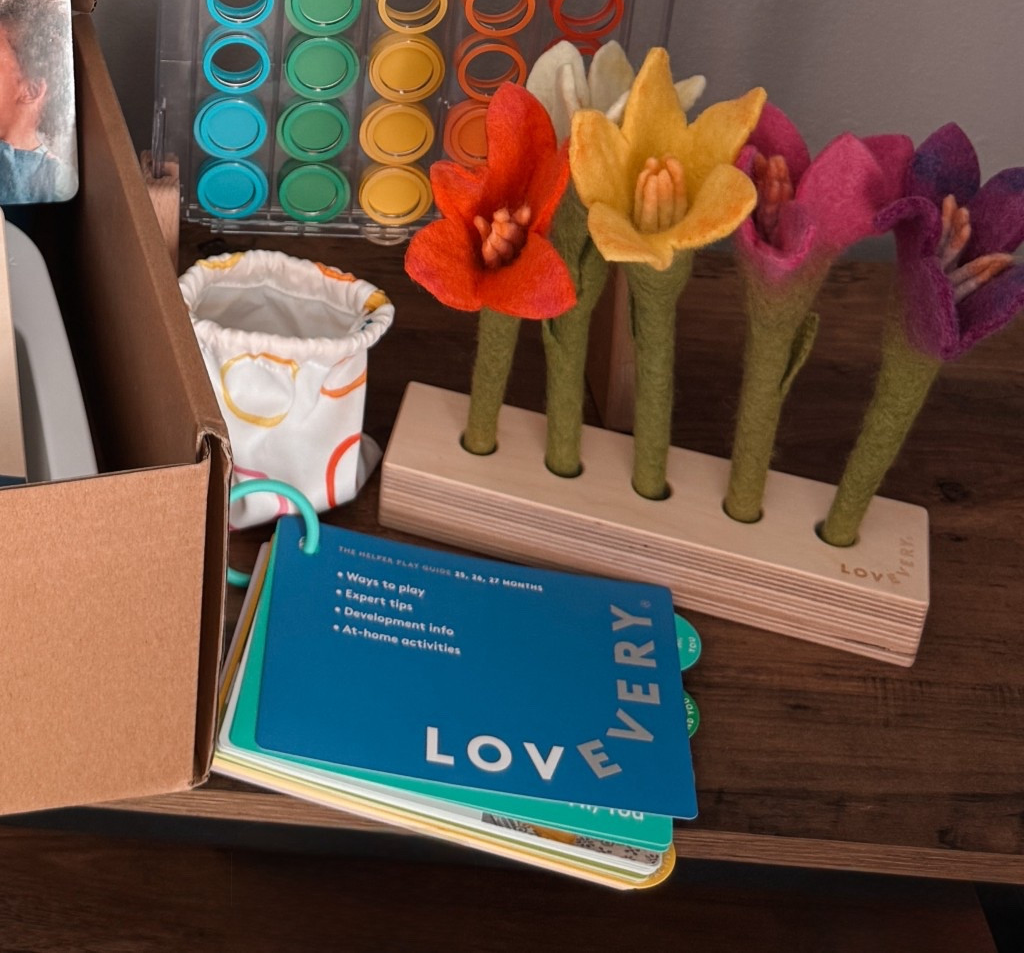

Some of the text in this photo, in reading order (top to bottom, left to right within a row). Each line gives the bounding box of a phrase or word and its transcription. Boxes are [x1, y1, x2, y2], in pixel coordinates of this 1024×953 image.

[338, 545, 356, 556] THE
[358, 550, 393, 564] HELPER
[396, 559, 420, 570] PLAY
[488, 576, 500, 584] 27
[502, 579, 543, 592] MONTHS
[346, 570, 425, 598] Ways to play
[345, 588, 413, 612] Expert tips
[344, 606, 454, 637] Development info
[342, 624, 461, 656] At-home activities
